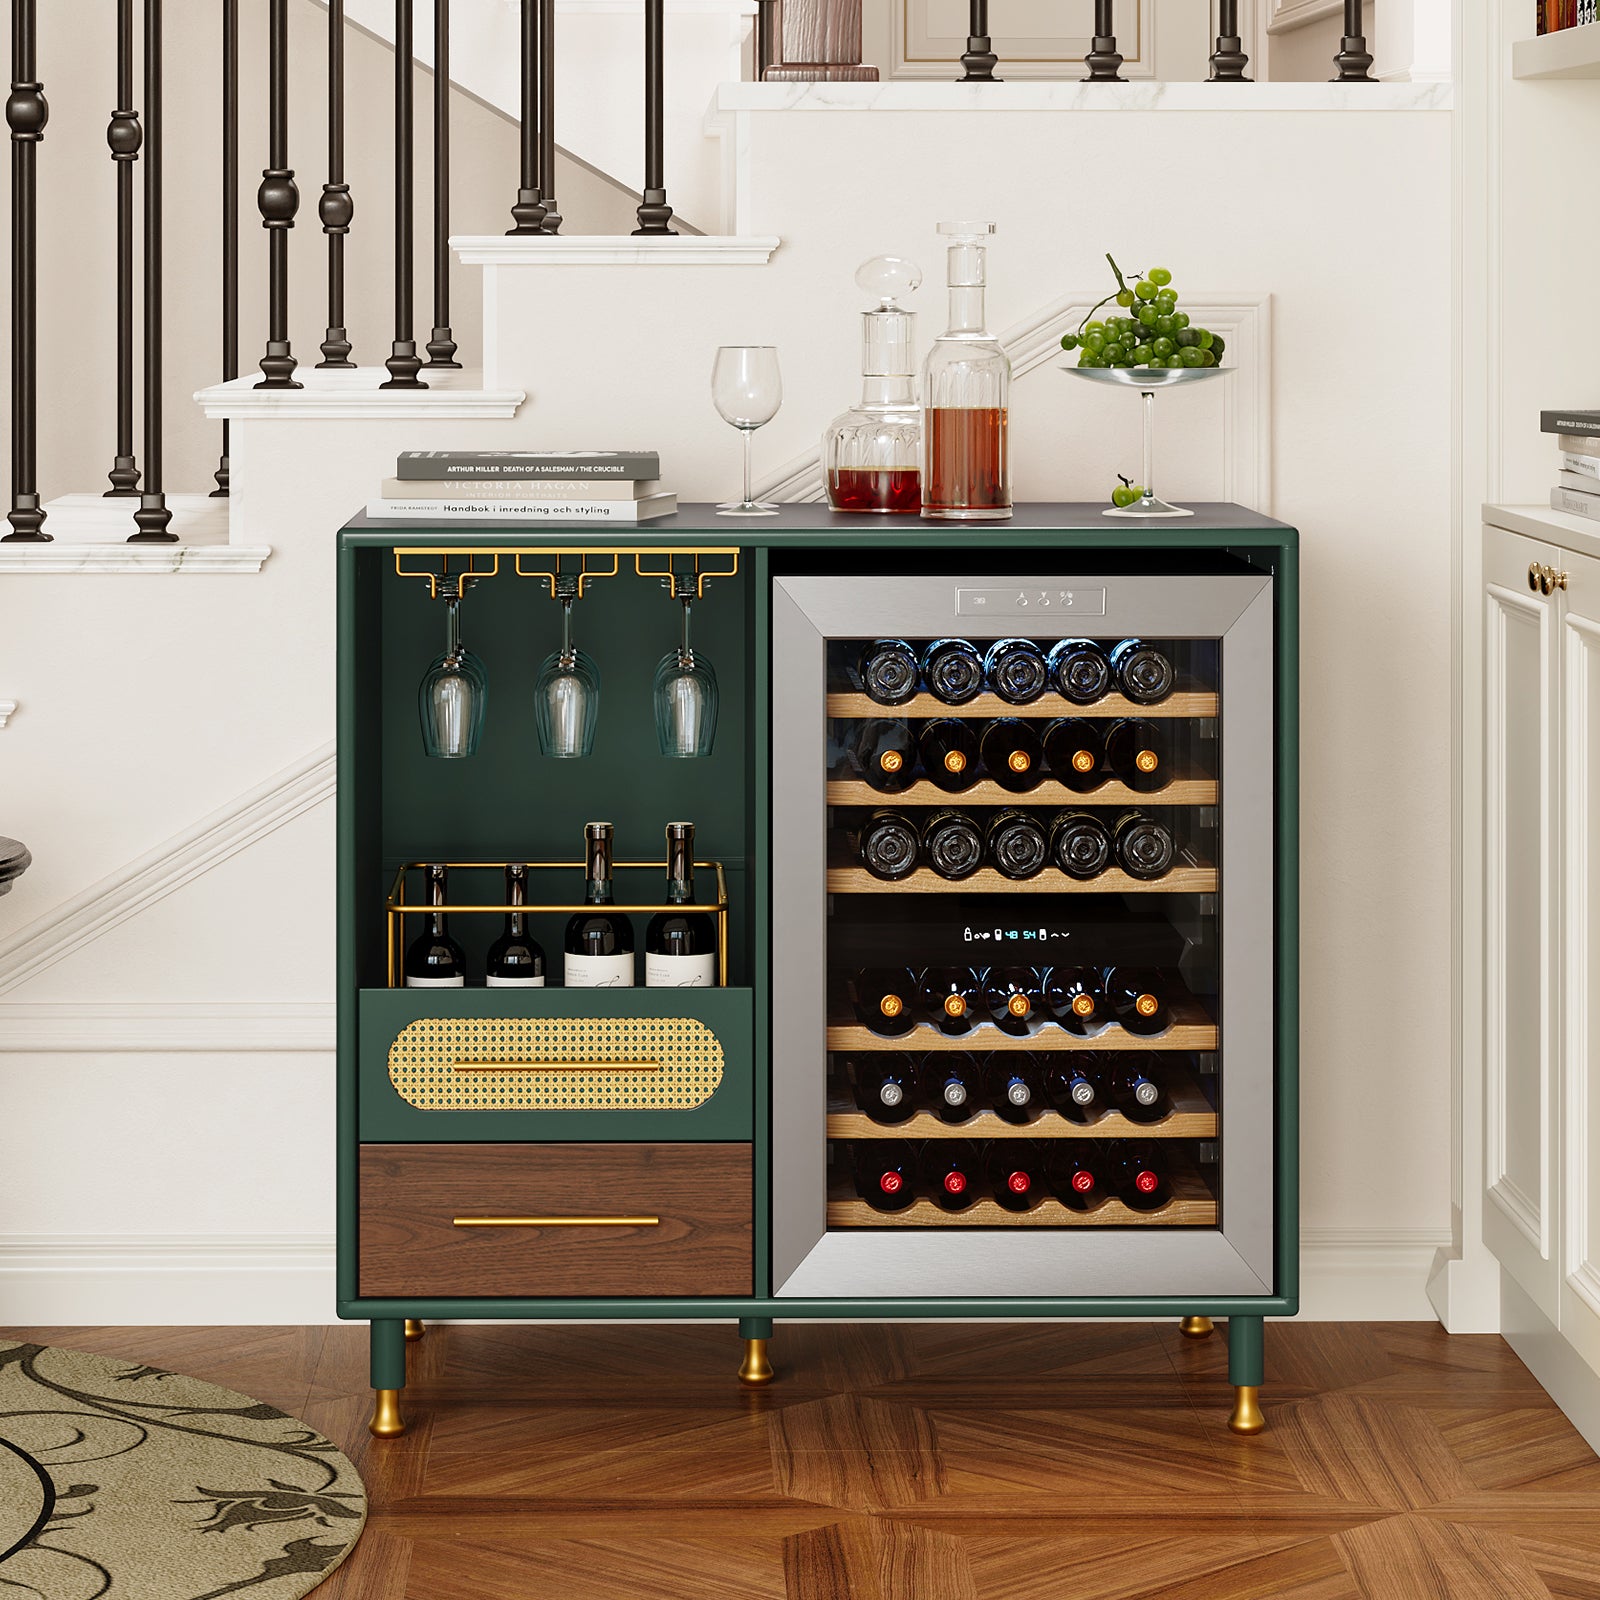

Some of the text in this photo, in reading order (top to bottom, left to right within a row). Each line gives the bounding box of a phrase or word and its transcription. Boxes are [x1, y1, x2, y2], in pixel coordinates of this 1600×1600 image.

[443, 481, 590, 490] VICTORIA HAGAN
[499, 505, 549, 515] inredning
[575, 506, 610, 515] styling
[1005, 930, 1036, 939] 48 54
